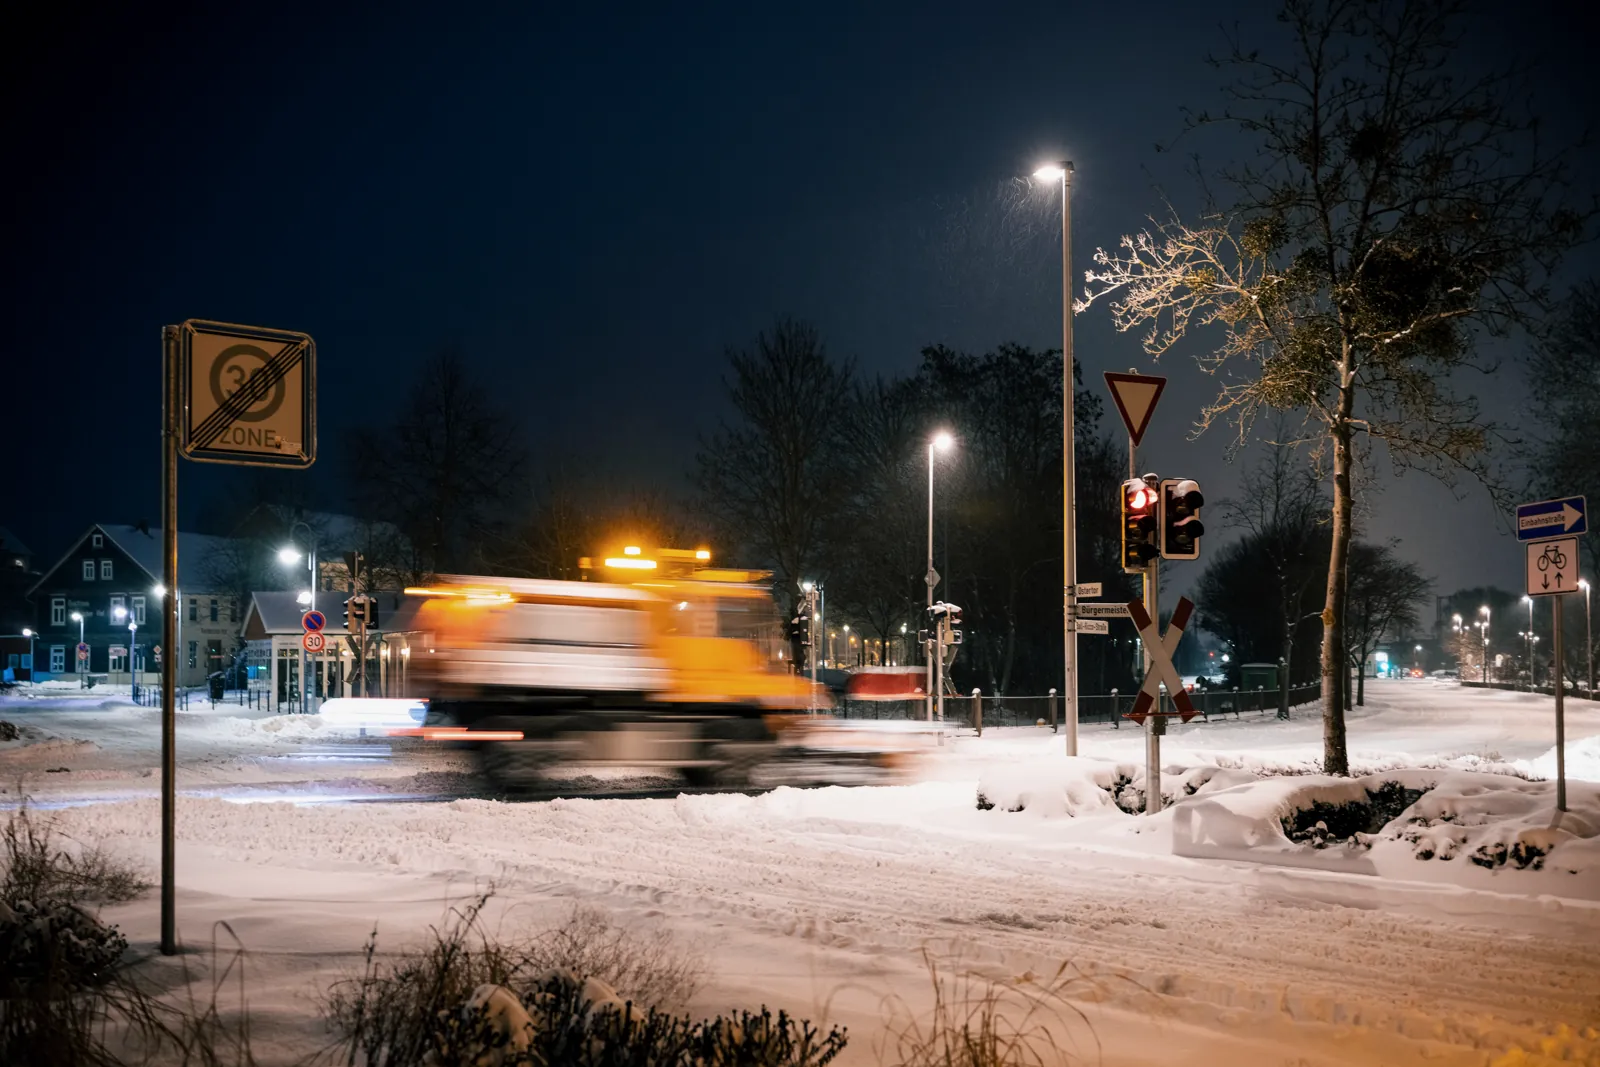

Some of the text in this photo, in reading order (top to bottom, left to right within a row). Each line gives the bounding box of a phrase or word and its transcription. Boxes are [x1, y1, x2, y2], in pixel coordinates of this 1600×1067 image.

[226, 364, 270, 402] 30
[219, 426, 276, 448] ZONE
[1520, 513, 1566, 528] Einbahnstraße
[1078, 586, 1099, 595] Ostertor
[1081, 606, 1129, 616] Bürgermeiste
[307, 636, 321, 647] 30
